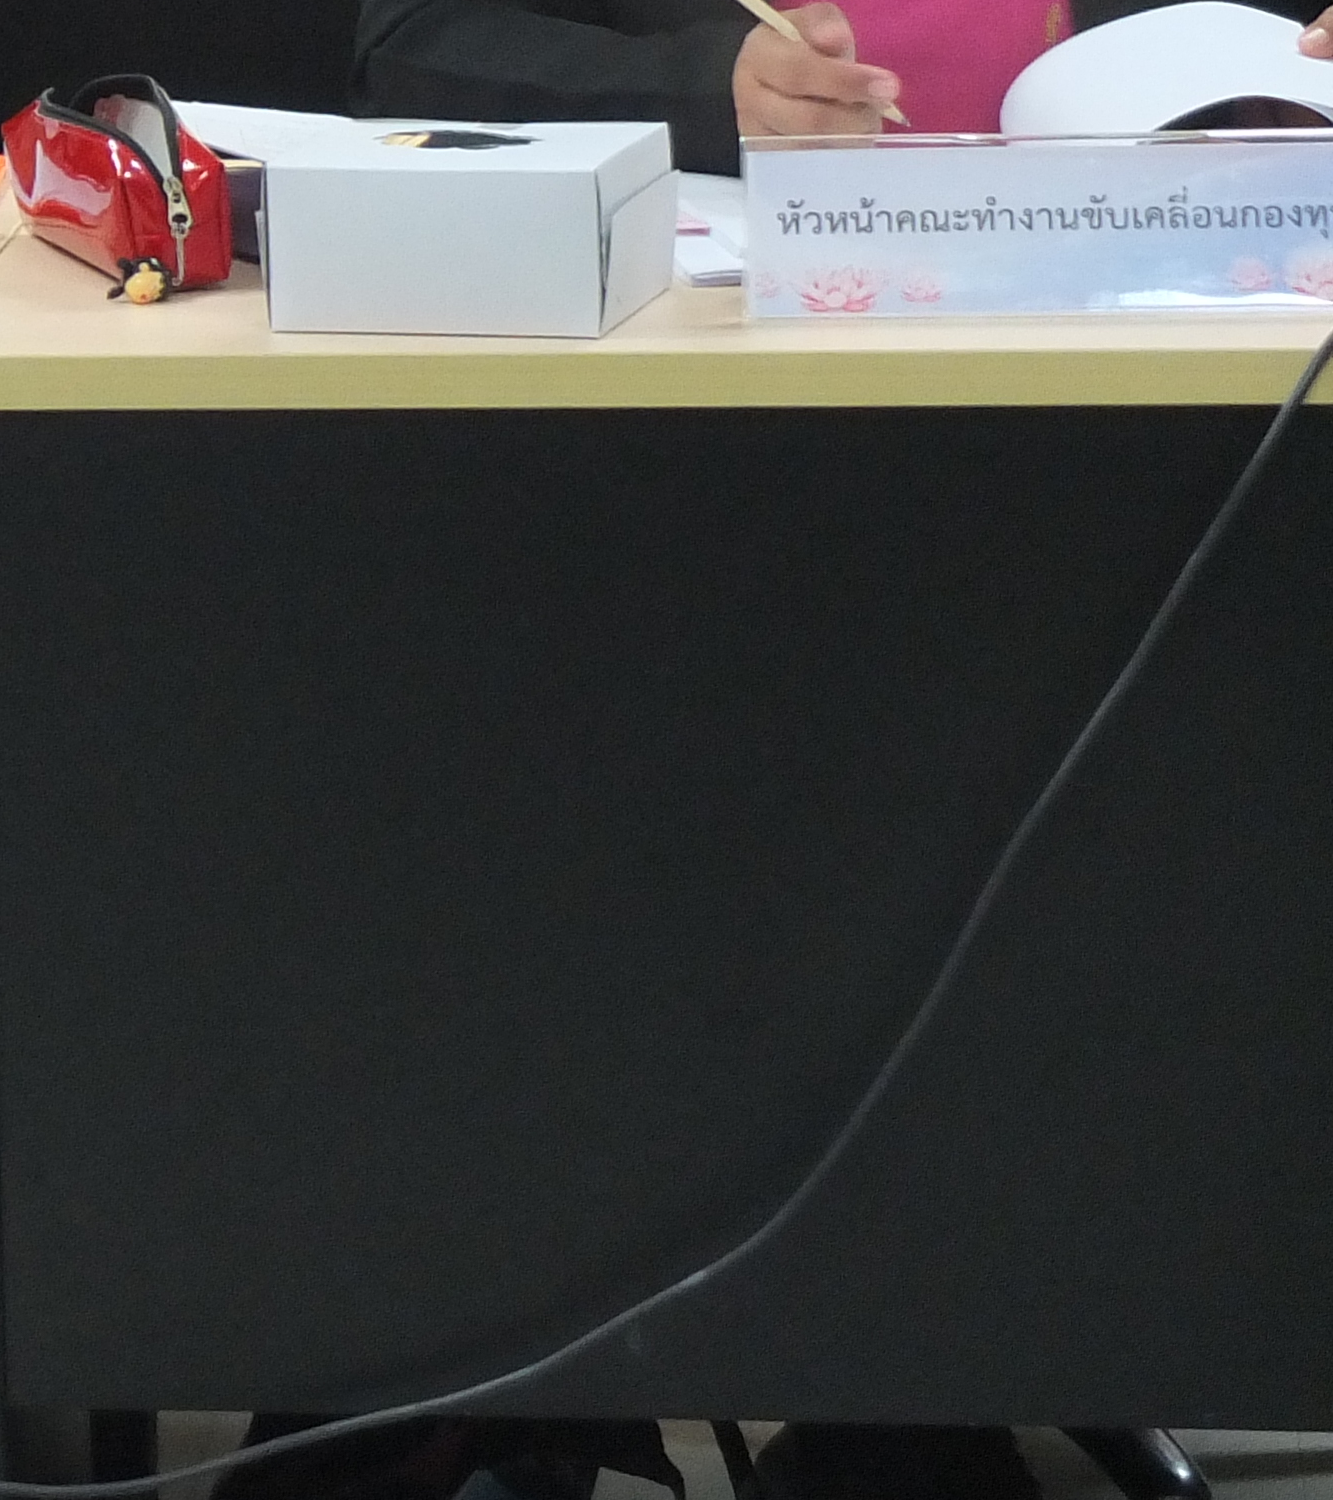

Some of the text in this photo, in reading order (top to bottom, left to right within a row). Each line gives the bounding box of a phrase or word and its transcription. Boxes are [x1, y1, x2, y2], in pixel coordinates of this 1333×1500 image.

[776, 186, 1333, 239] หัวหน้าคณะทำงานขับเคลื่อนกองทุ
